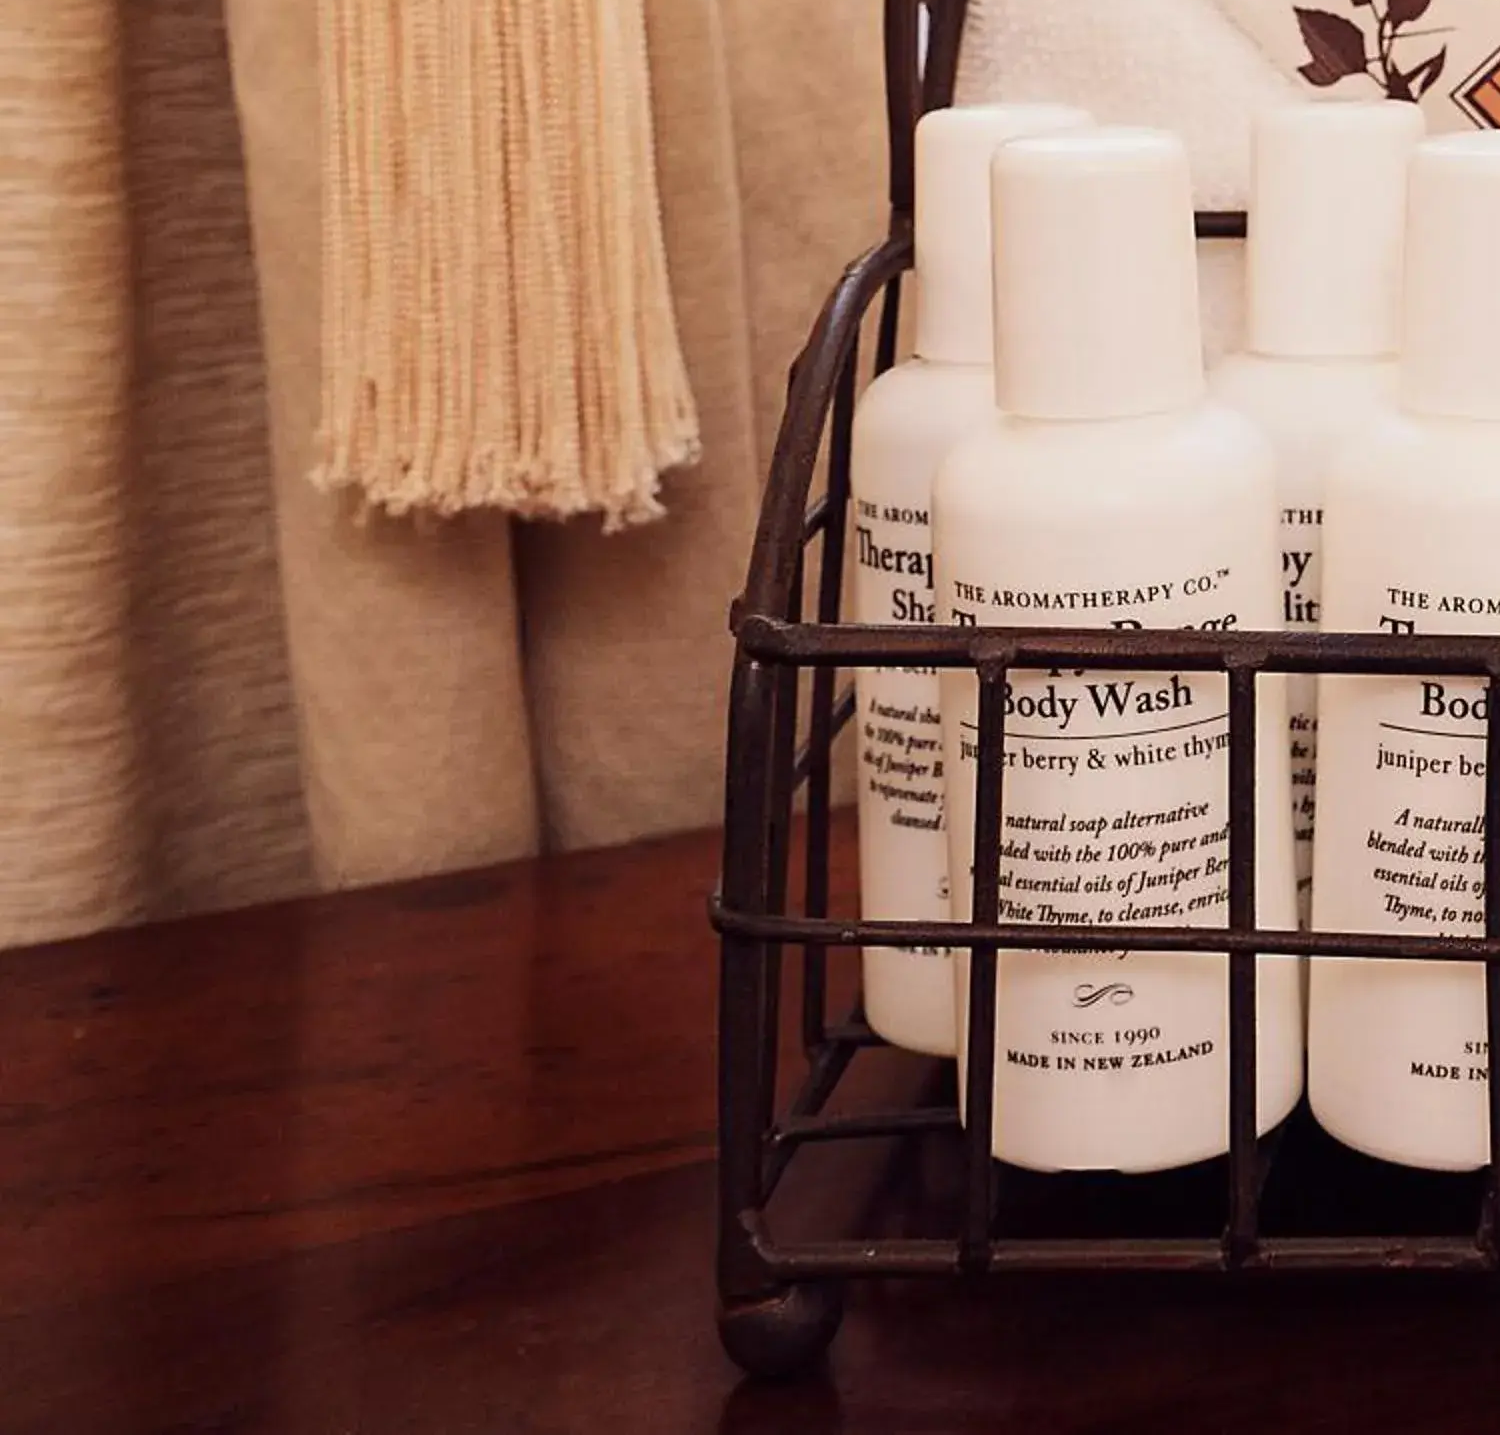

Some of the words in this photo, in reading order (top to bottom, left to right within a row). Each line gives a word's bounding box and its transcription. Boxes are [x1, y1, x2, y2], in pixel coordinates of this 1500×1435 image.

[953, 580, 985, 604] THE
[991, 582, 1174, 609] AROMATHERAPY
[1387, 587, 1429, 609] THE
[1085, 674, 1193, 717] Wash
[1023, 748, 1079, 776] berry
[1087, 748, 1106, 770] &
[1115, 743, 1176, 768] white
[1183, 732, 1229, 763] thym
[1376, 743, 1451, 778] juniper
[1006, 813, 1066, 833] natural
[1070, 817, 1107, 839] soap
[1112, 801, 1210, 830] alternative
[1394, 808, 1411, 827] A
[1413, 814, 1486, 841] naturall
[1034, 843, 1071, 863] with
[1076, 844, 1102, 863] the
[1107, 841, 1157, 862] 100%
[1158, 836, 1196, 862] pure
[1367, 829, 1425, 859] blended
[1428, 843, 1469, 865] with
[1015, 872, 1080, 894] essential
[1084, 873, 1113, 894] oils
[1117, 872, 1136, 898] of
[1135, 865, 1201, 894] Juniper
[1373, 866, 1437, 890] essential
[1440, 872, 1469, 893] oils
[1097, 907, 1113, 923] to
[1384, 893, 1437, 922] Thyme,
[1441, 905, 1457, 923] to
[1049, 1030, 1106, 1046] SINCE
[1114, 1025, 1162, 1048] 1990
[1006, 1048, 1050, 1069] MADE
[1056, 1055, 1077, 1071] IN
[1083, 1055, 1124, 1072] NEW
[1130, 1039, 1214, 1069] ZEALAND
[1410, 1061, 1461, 1081] MADE
